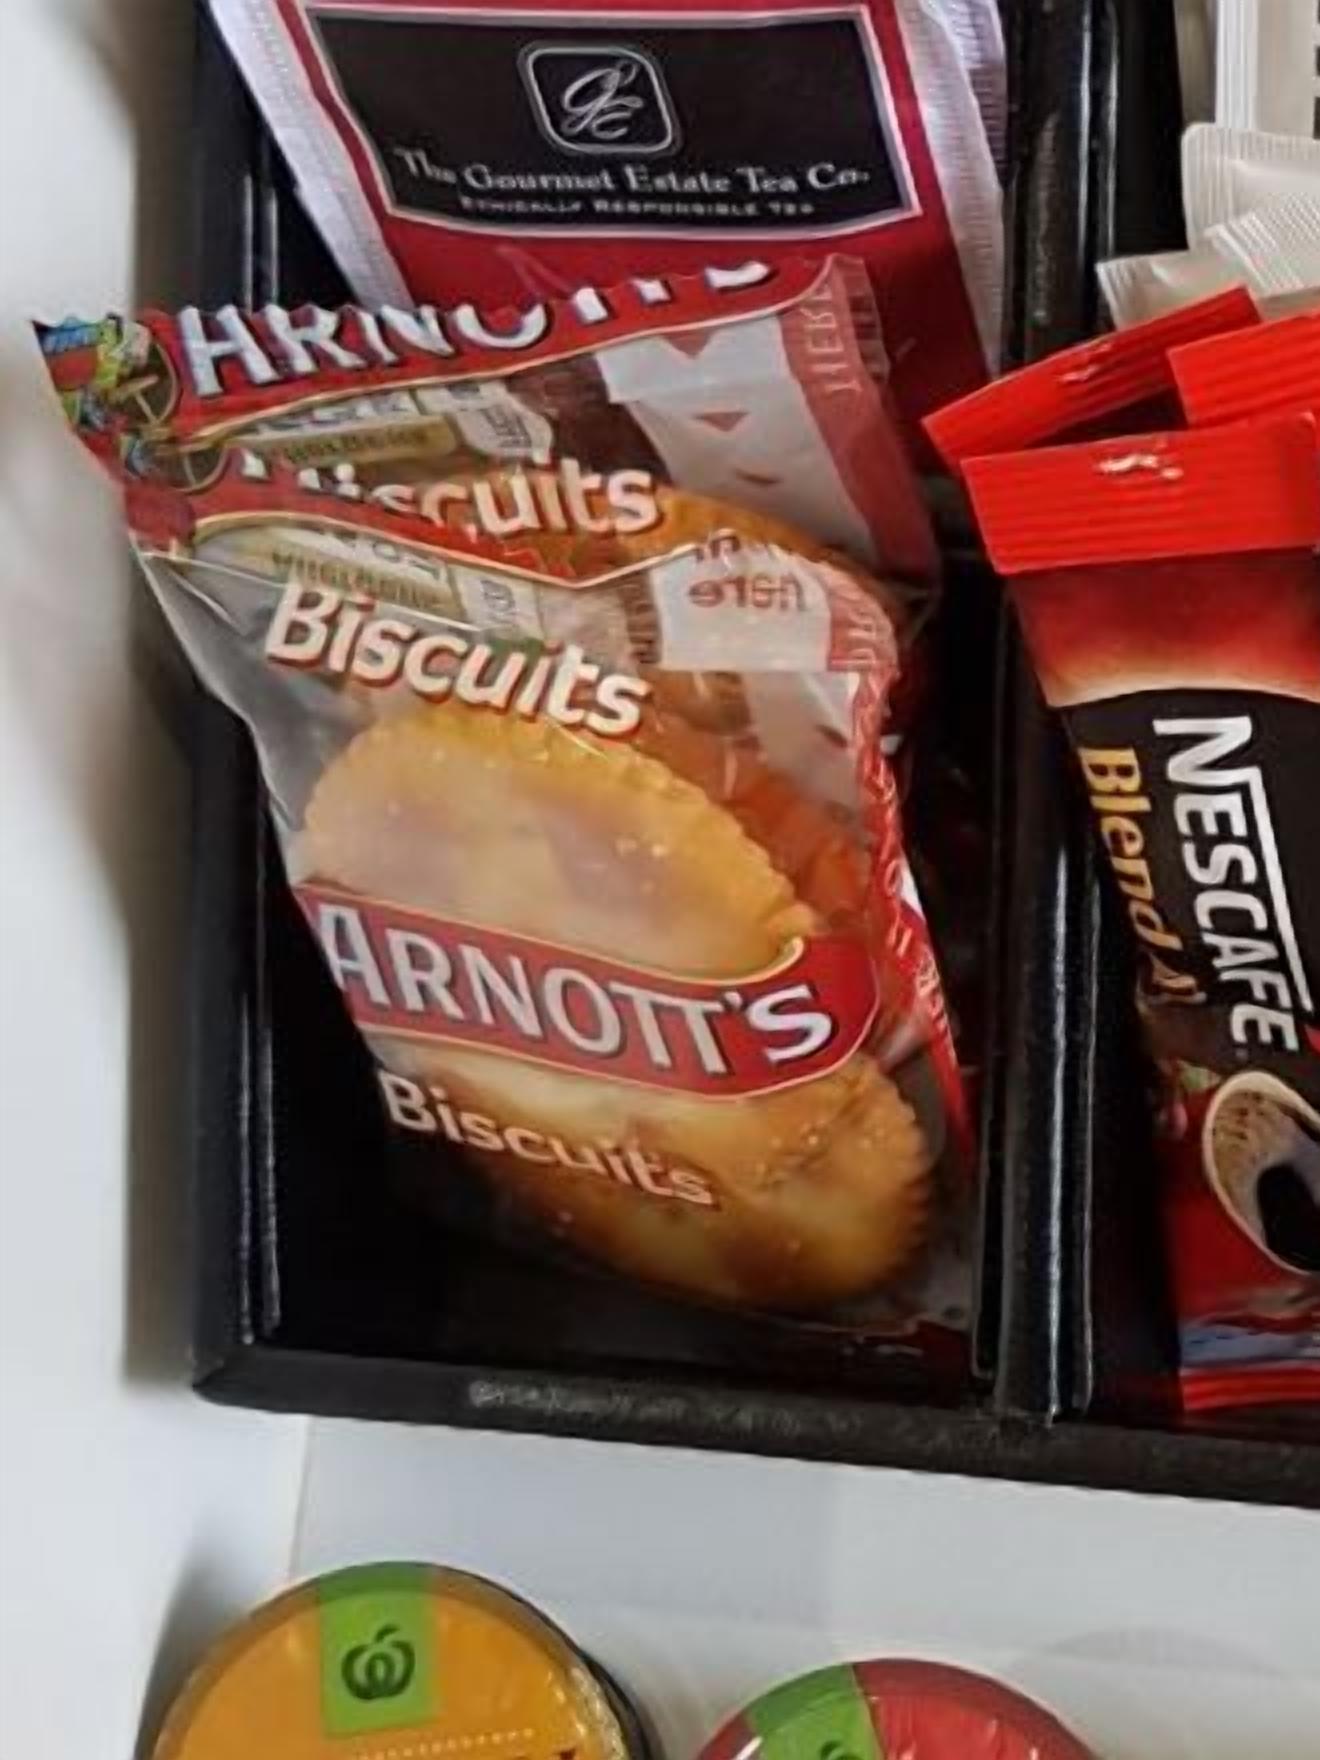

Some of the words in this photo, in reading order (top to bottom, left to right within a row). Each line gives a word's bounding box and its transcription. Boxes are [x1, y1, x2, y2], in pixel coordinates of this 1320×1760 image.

[392, 145, 458, 185] The
[463, 164, 616, 192] Gourmet
[622, 163, 731, 195] Estate
[736, 166, 799, 195] Tea
[264, 572, 653, 737] Biscuits
[1078, 747, 1184, 951] Blend
[315, 901, 837, 1076] ARNOTT'S
[376, 1069, 716, 1207] Biscuits
